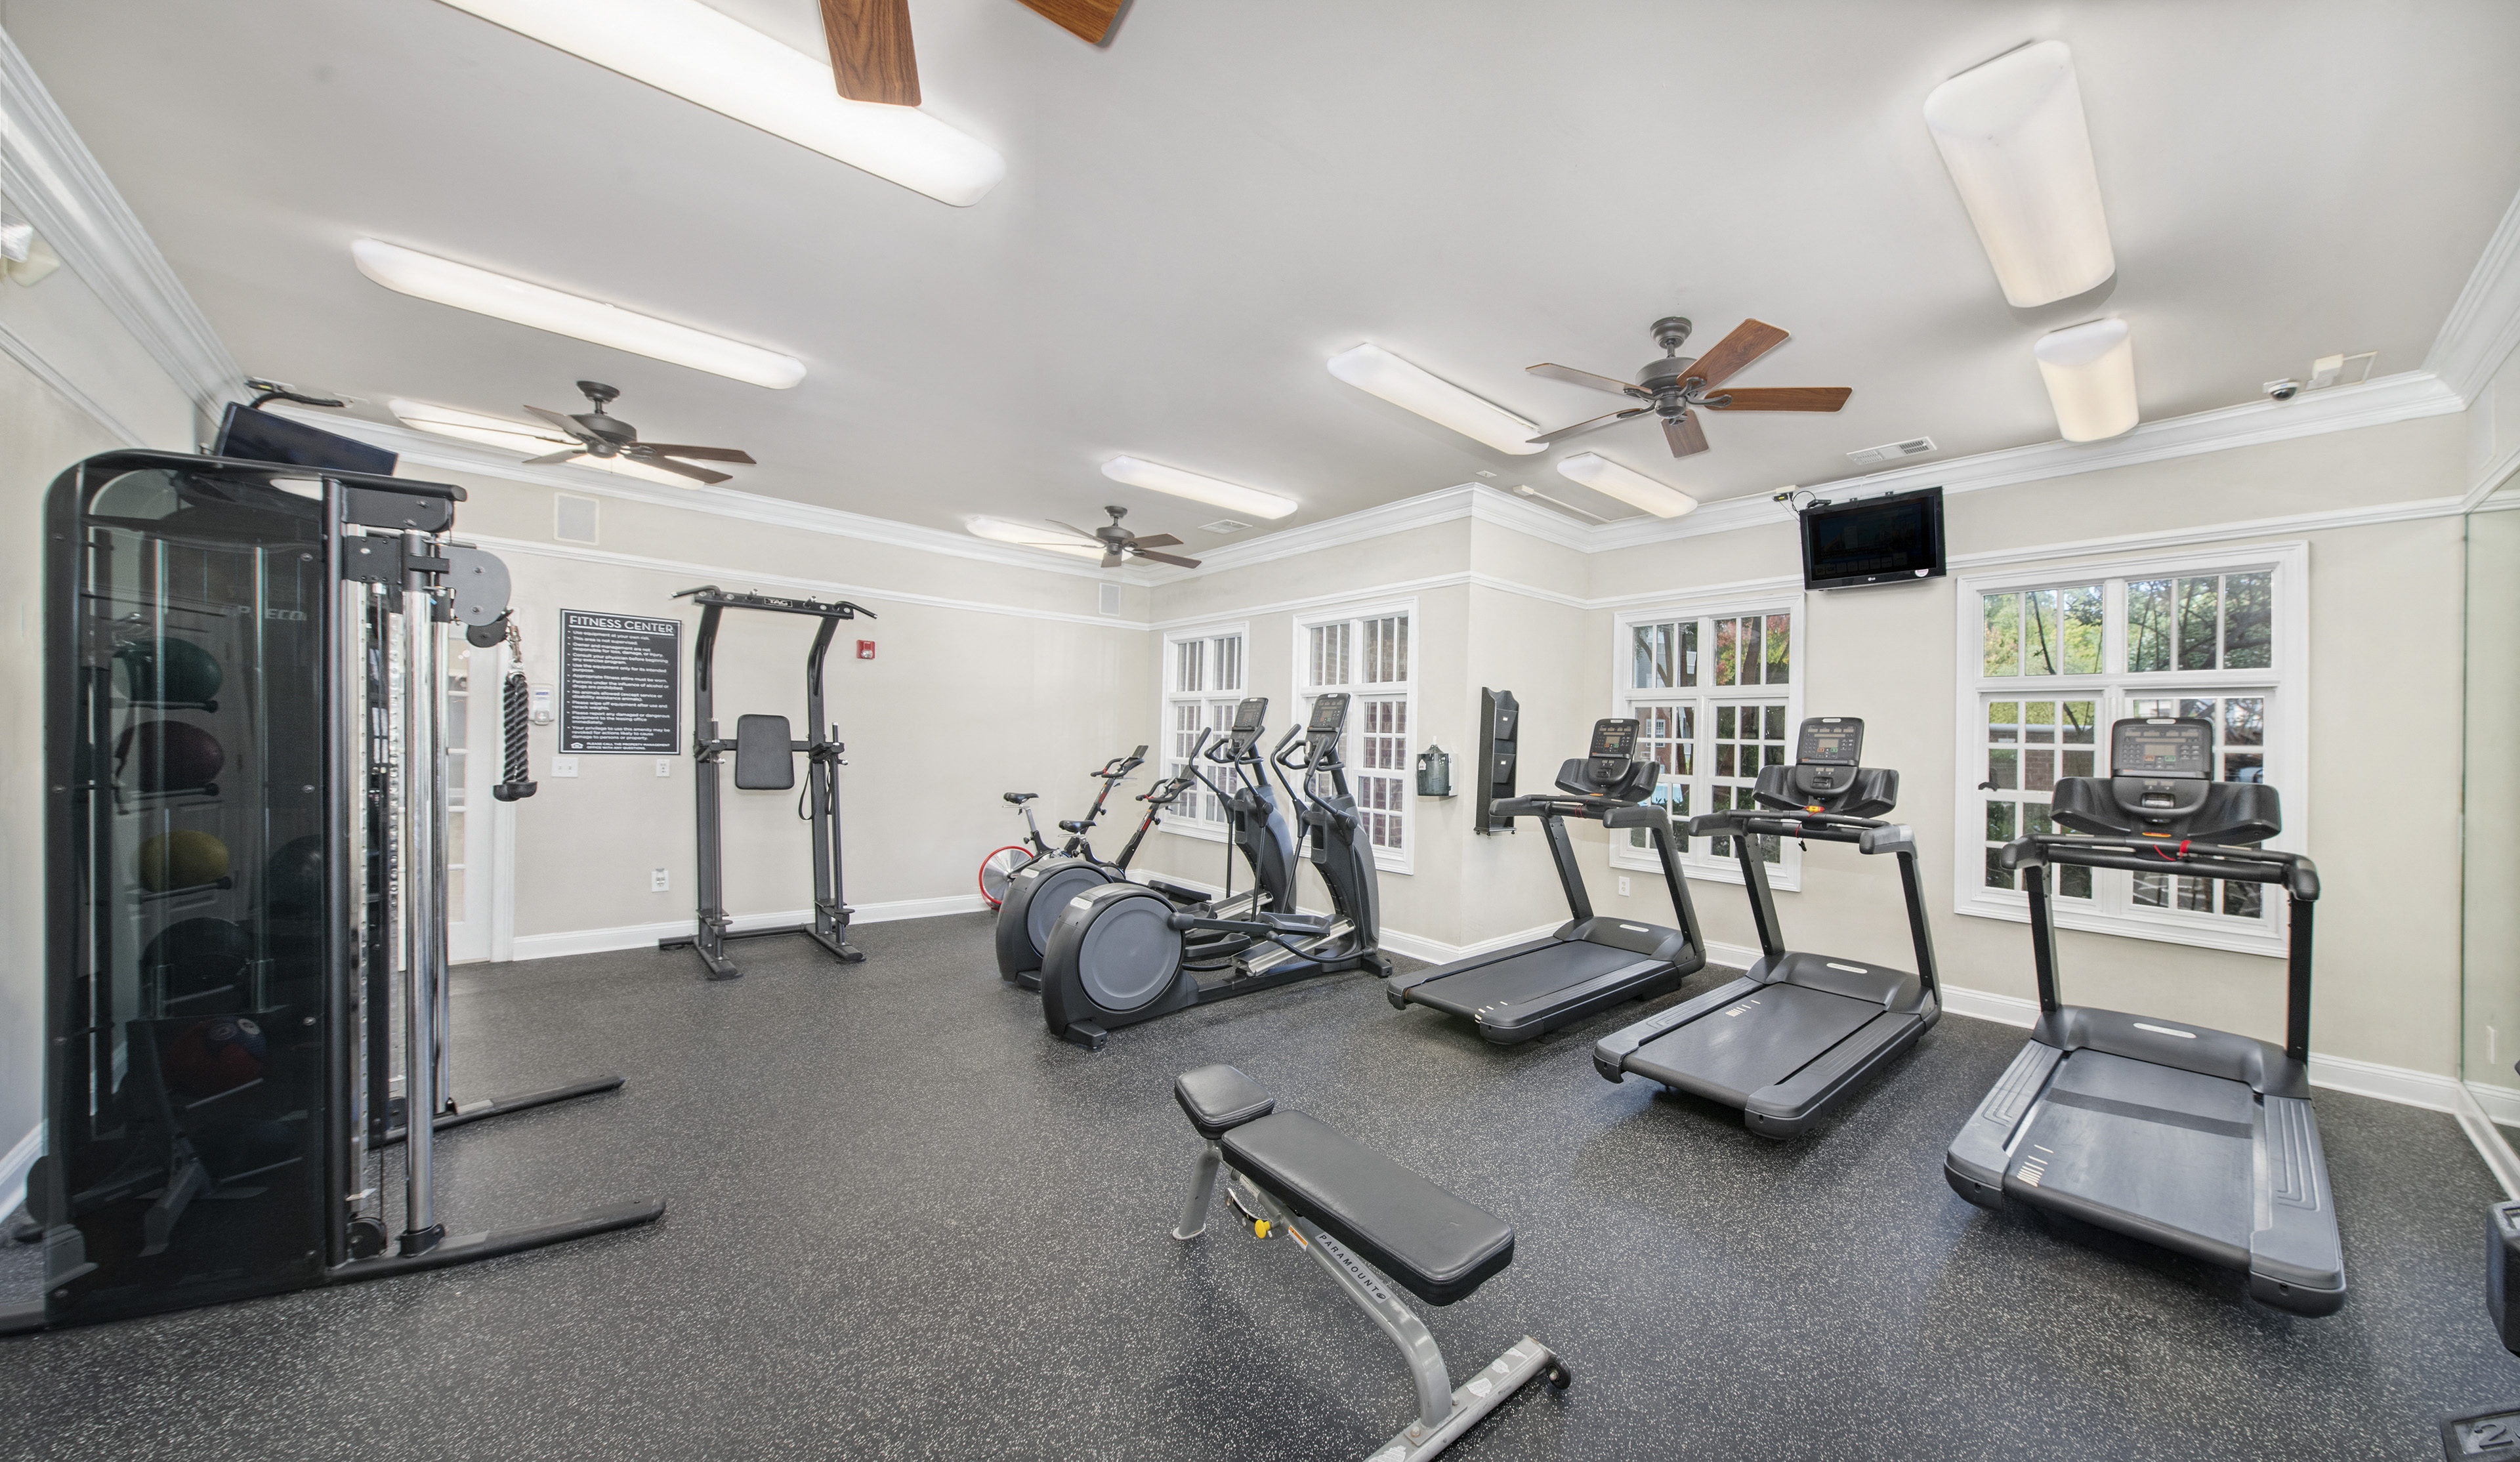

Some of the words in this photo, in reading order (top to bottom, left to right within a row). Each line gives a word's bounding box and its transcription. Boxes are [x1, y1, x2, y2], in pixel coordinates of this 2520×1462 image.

[237, 605, 307, 621] PECO
[570, 616, 621, 628] FITNESS
[624, 621, 673, 633] CENTER
[1319, 1234, 1379, 1292] PARAMOUNT
